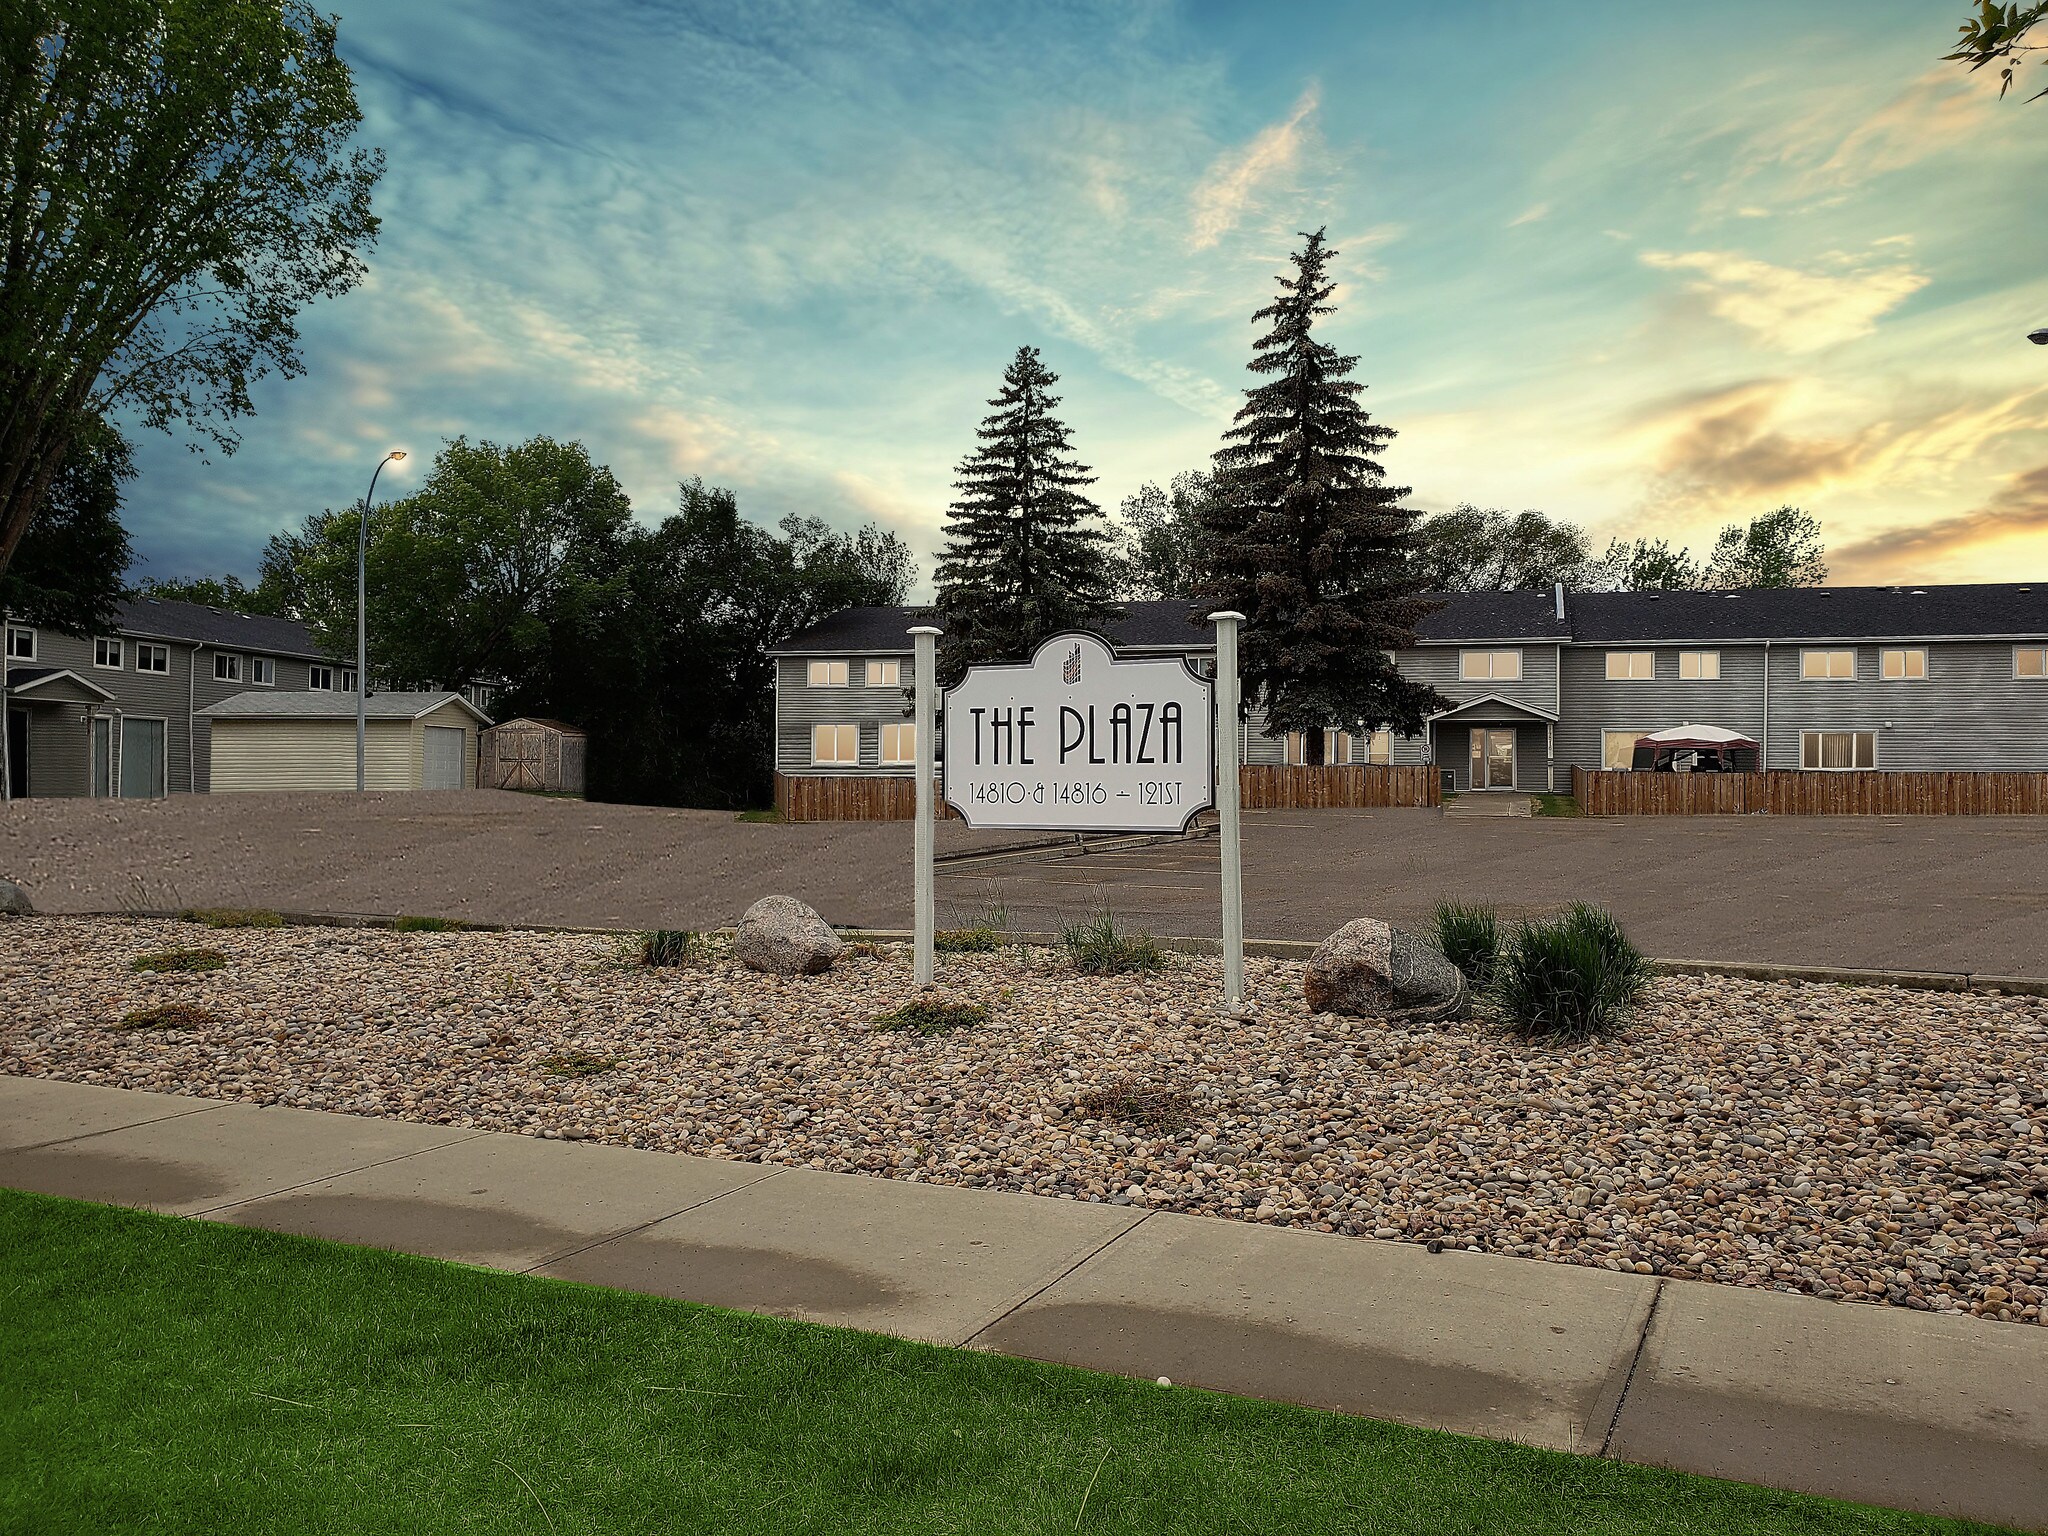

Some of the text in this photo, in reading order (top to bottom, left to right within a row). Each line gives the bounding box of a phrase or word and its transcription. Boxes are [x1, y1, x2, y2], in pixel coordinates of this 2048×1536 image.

[969, 701, 1182, 765] THE PLAZA
[969, 782, 1026, 804] 14810
[1032, 782, 1045, 804] &
[1053, 782, 1107, 804] 14816
[1138, 781, 1182, 804] 121ST
